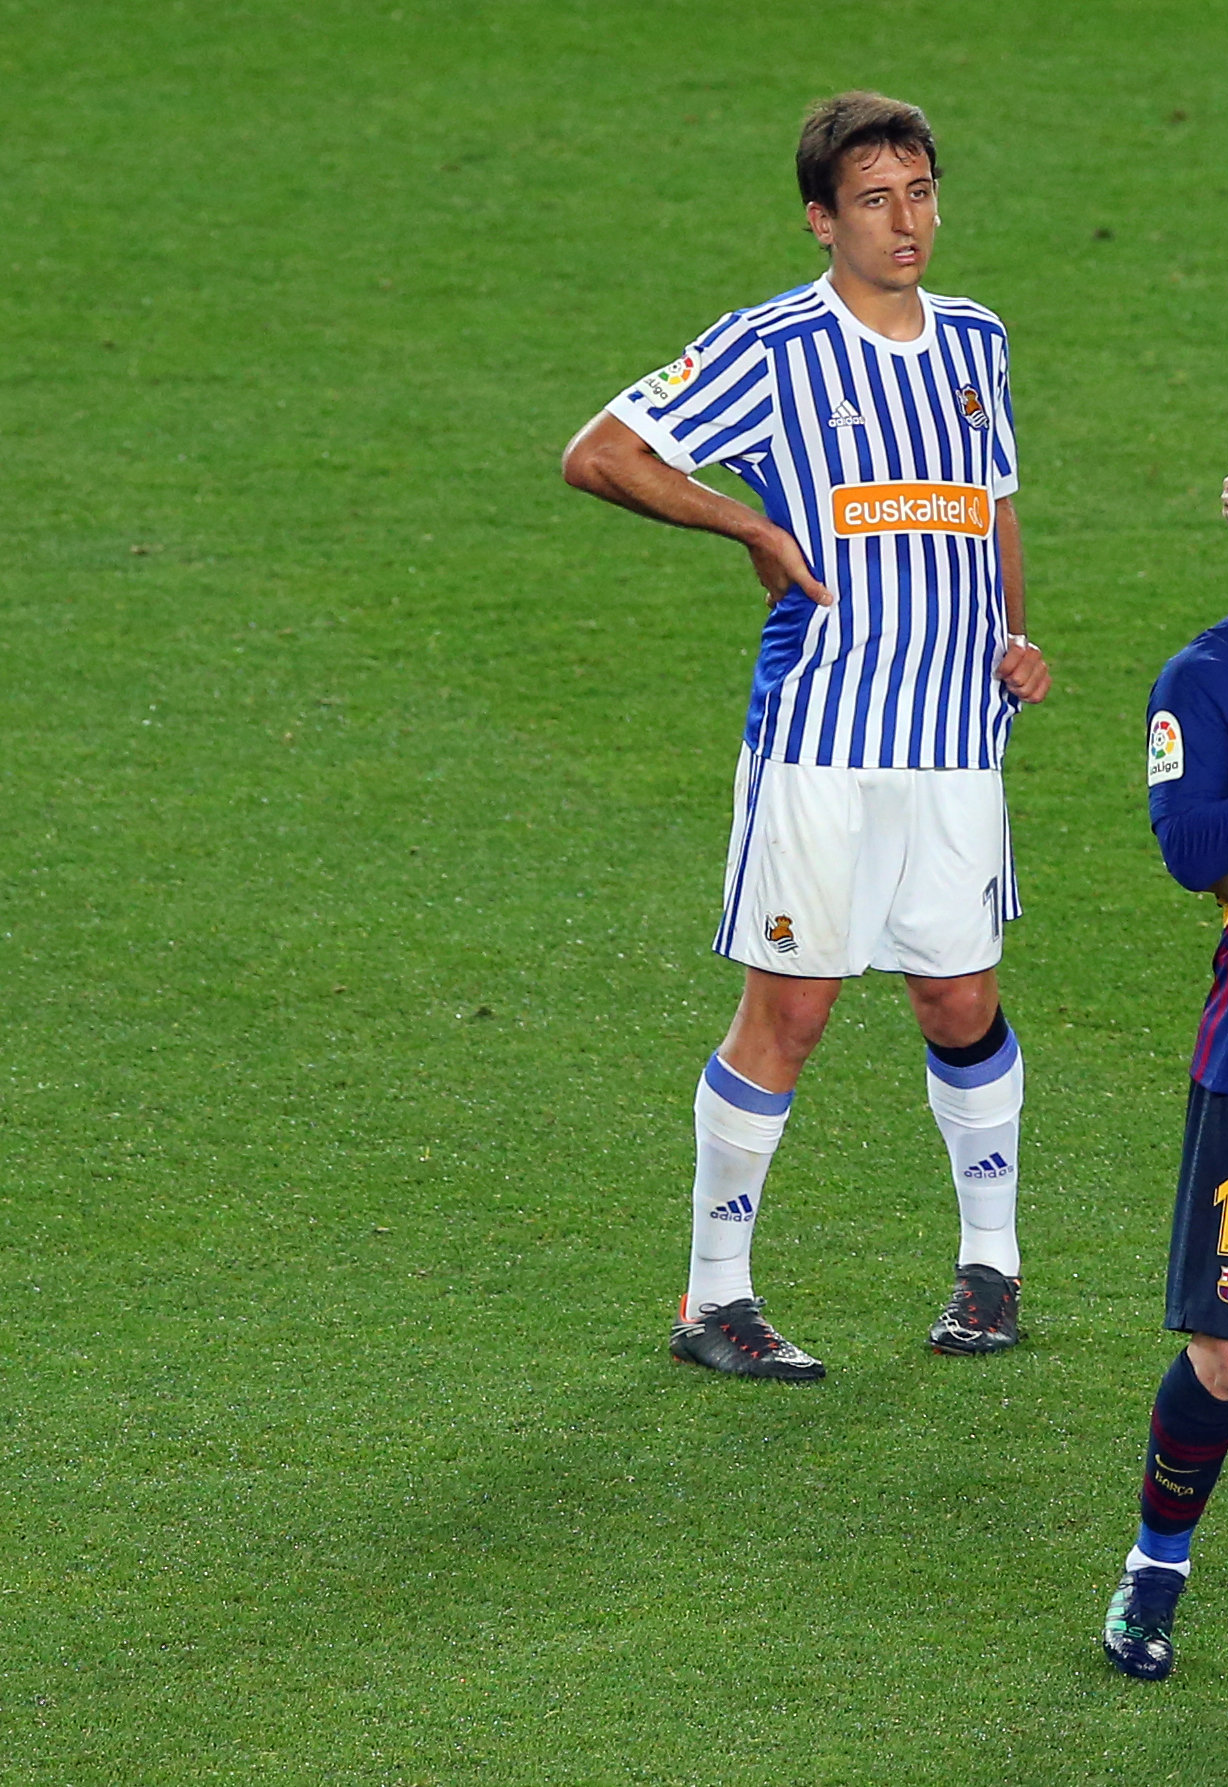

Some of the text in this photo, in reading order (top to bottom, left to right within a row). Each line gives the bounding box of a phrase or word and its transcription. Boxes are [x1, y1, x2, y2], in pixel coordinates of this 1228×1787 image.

[828, 416, 866, 428] adidas
[844, 493, 965, 525] euskaltel
[710, 1210, 755, 1222] adida
